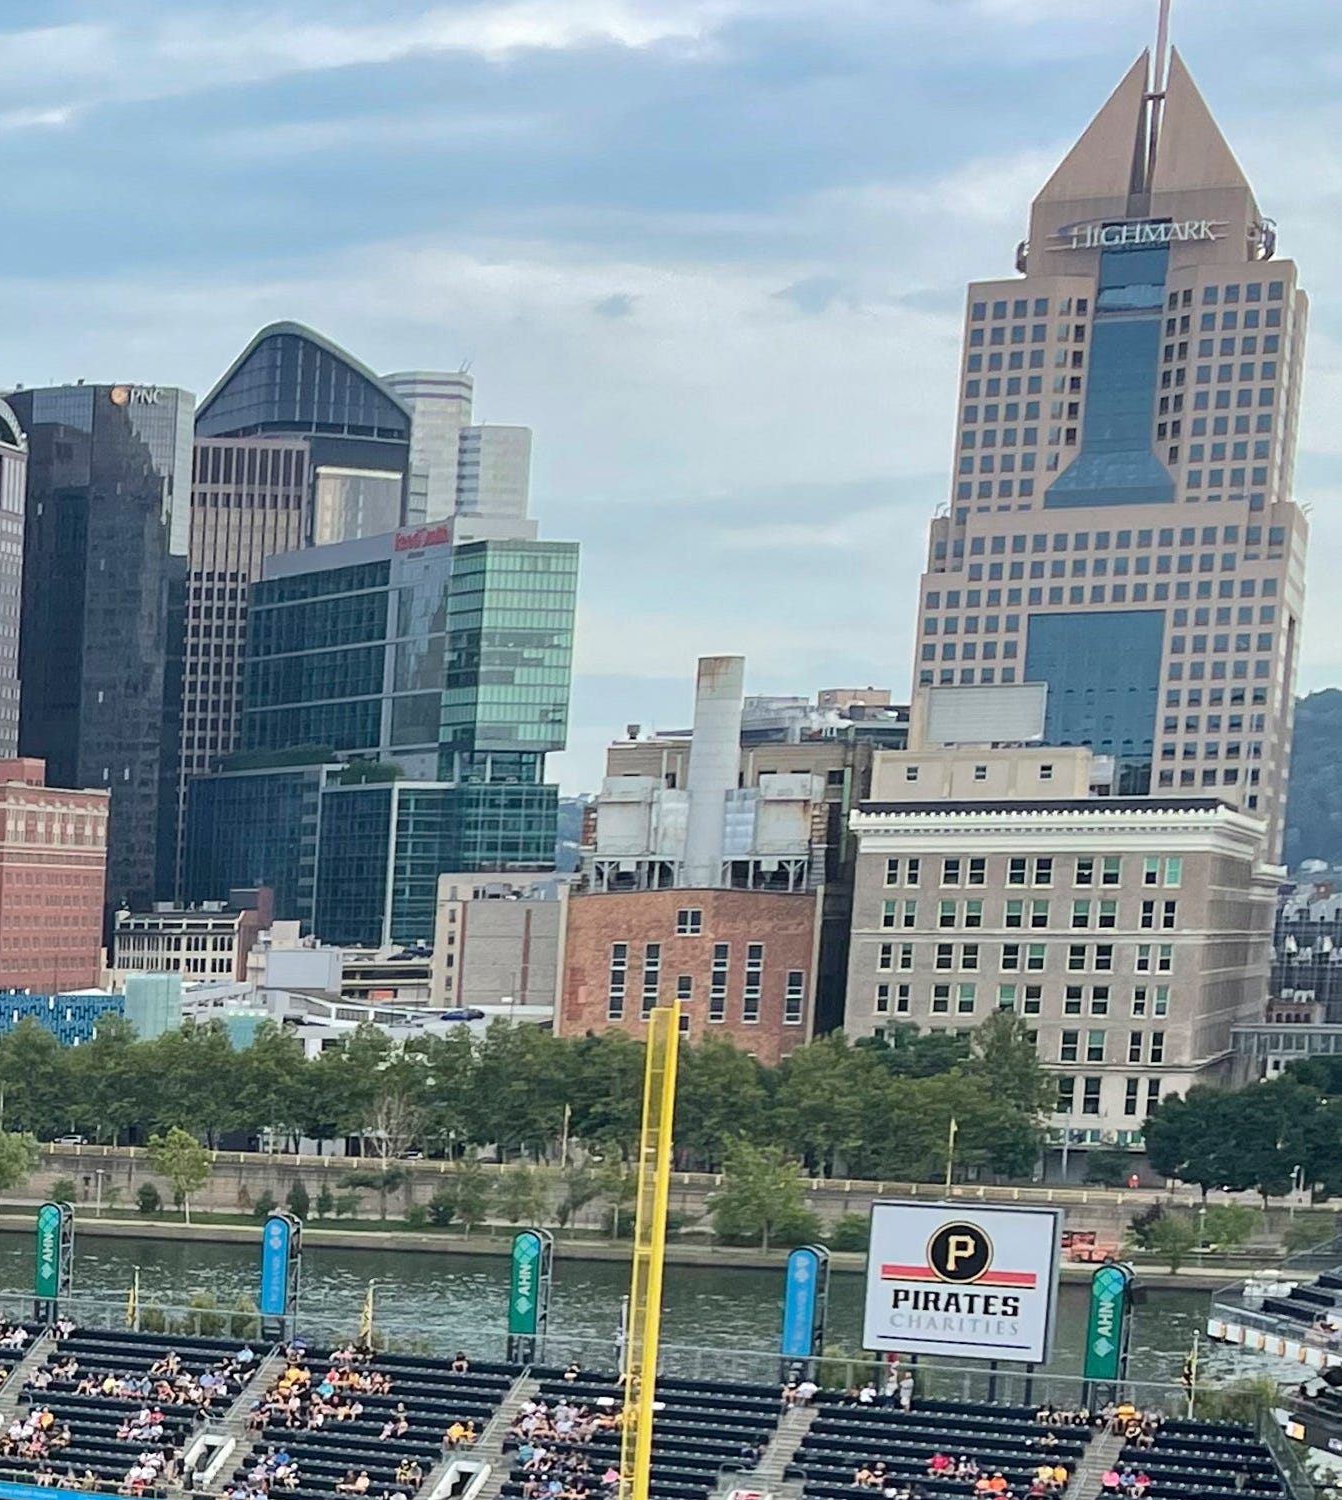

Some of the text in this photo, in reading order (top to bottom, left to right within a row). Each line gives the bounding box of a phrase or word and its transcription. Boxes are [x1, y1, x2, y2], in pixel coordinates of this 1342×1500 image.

[1072, 219, 1215, 249] HIGHMARK
[130, 388, 164, 405] PNC
[42, 1232, 54, 1263] AHN
[946, 1234, 976, 1272] P
[517, 1262, 532, 1296] AHN
[892, 1289, 1020, 1317] PIRATES
[1096, 1299, 1115, 1337] AHN
[889, 1312, 1019, 1337] CHARITIES
